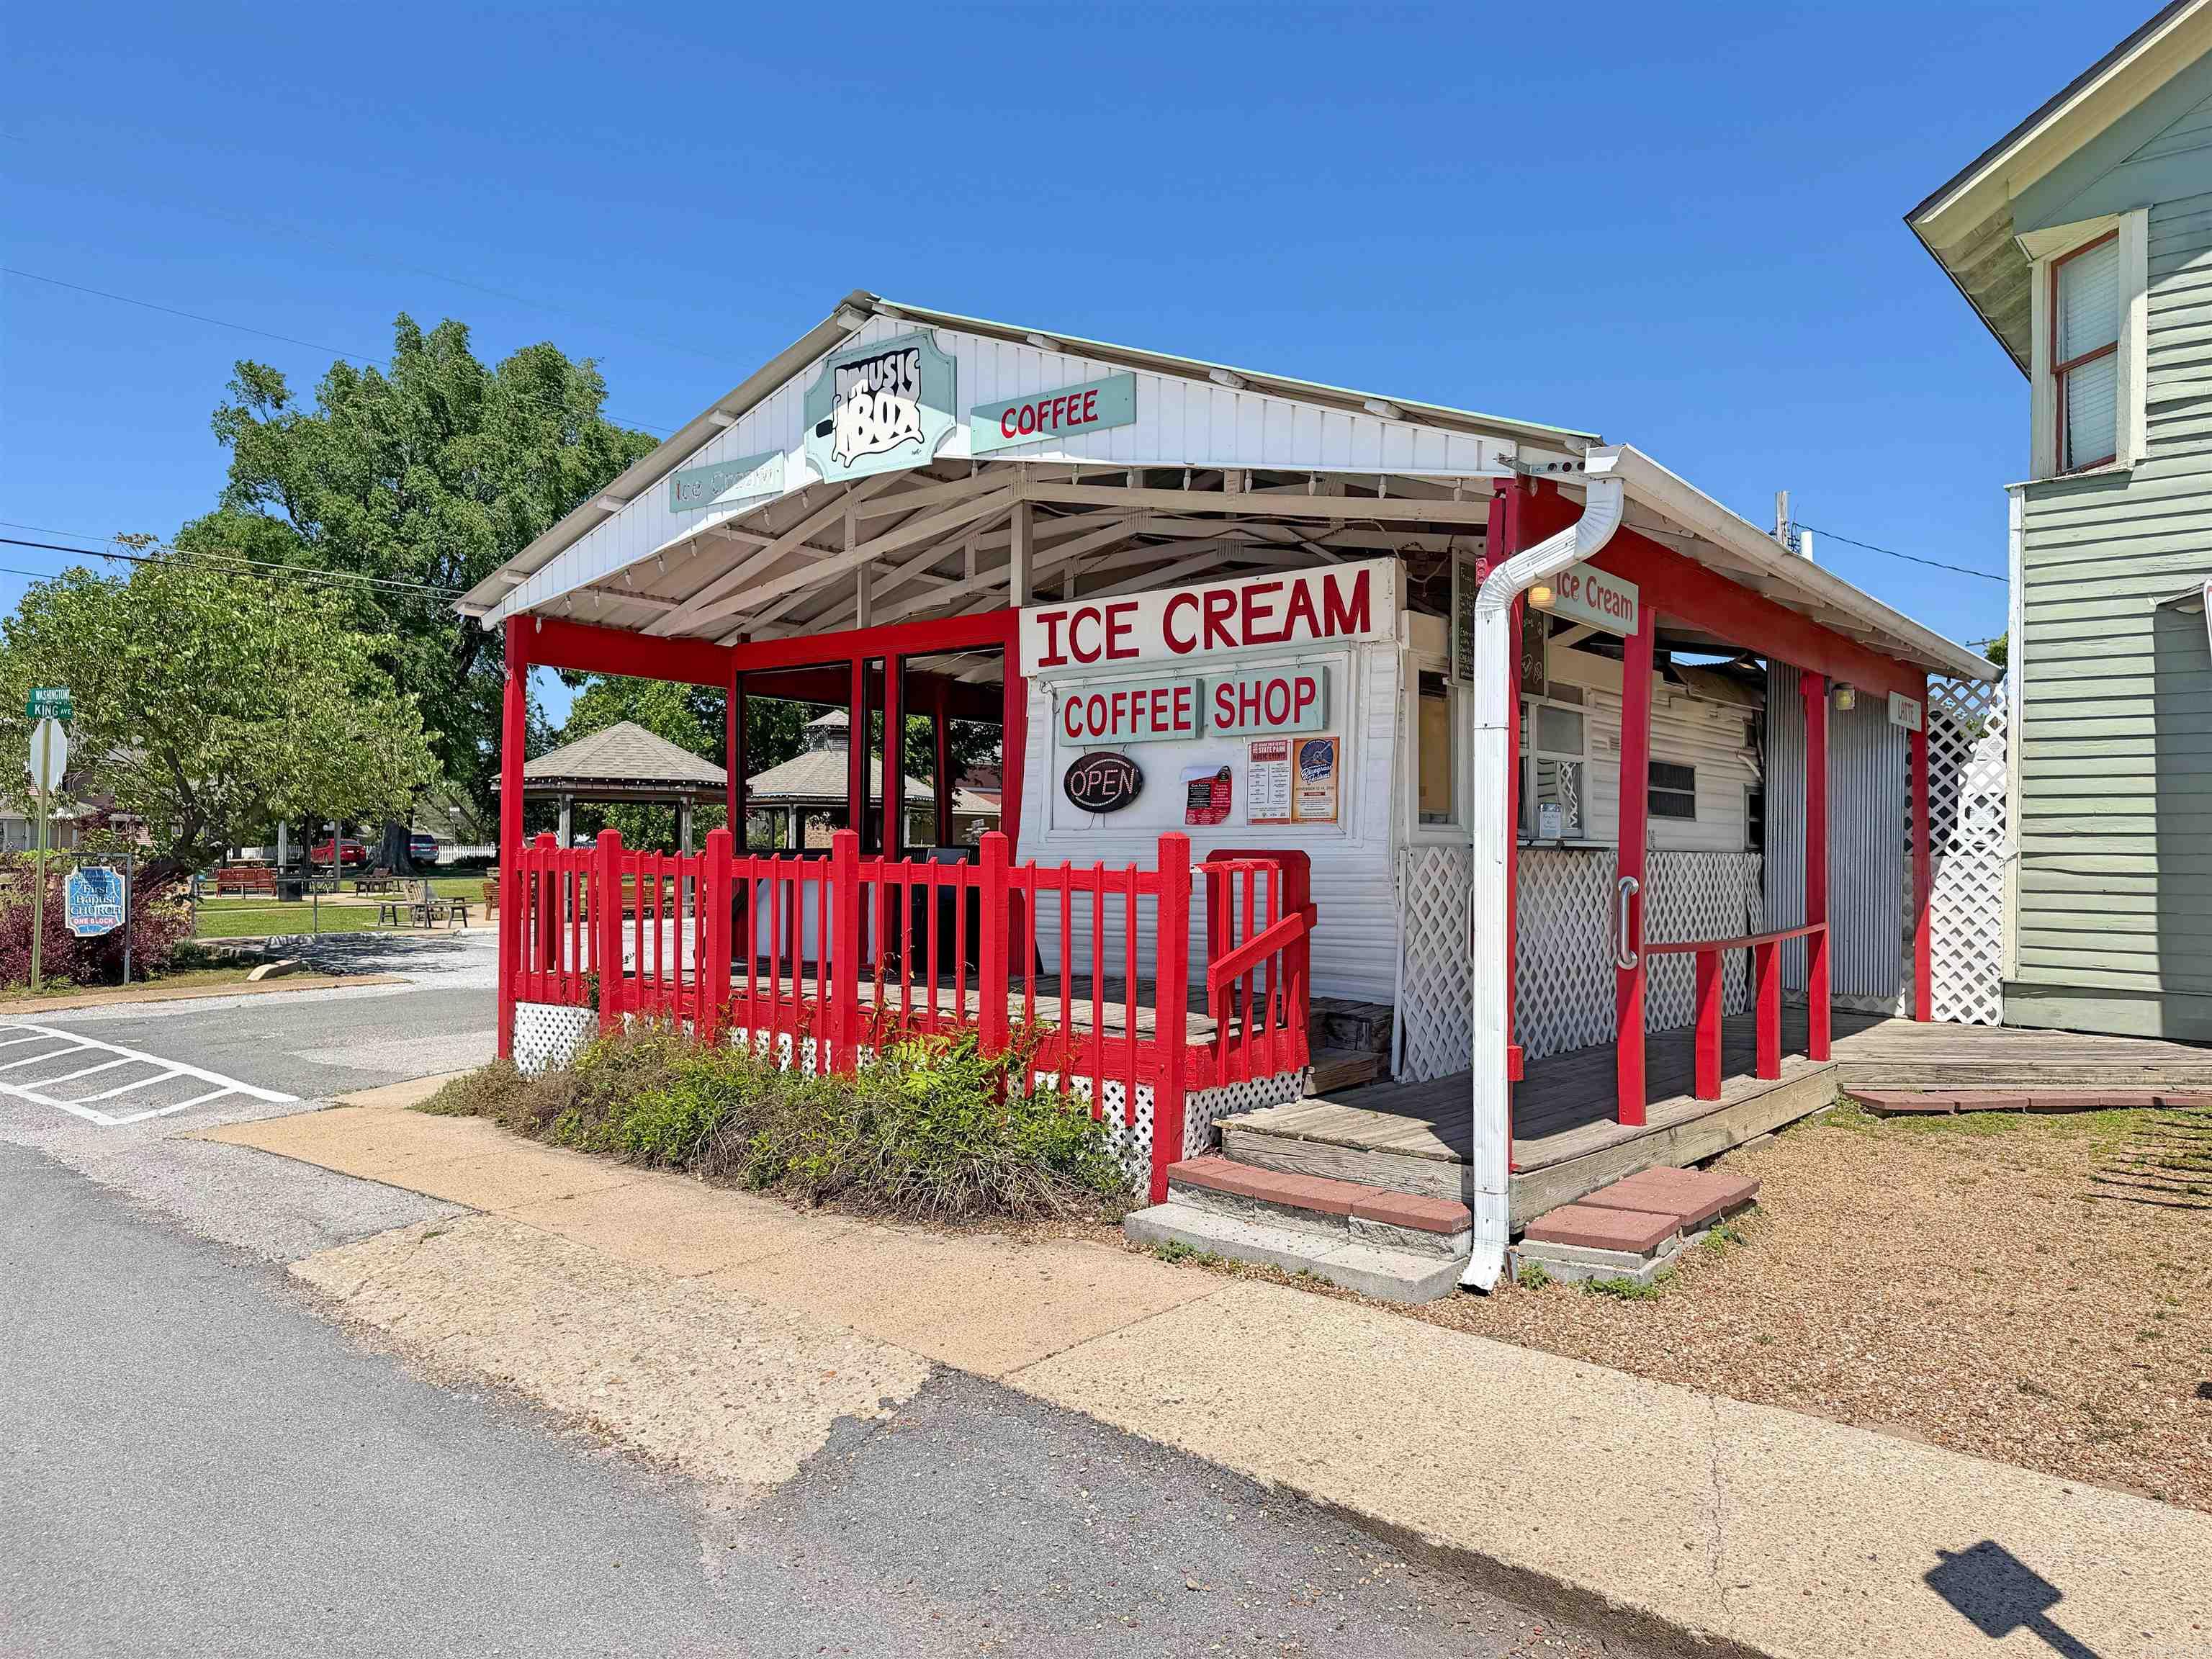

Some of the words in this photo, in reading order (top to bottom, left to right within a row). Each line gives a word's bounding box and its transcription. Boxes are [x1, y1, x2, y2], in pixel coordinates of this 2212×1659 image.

[835, 349, 920, 399] MUSIC
[836, 387, 925, 461] BOX
[1001, 390, 1098, 439] COFFEE
[676, 480, 703, 502] Ice
[1556, 571, 1580, 601] Ice
[1586, 576, 1633, 622] Cream
[1037, 601, 1140, 668] ICE
[1162, 569, 1371, 655] CREAM
[35, 688, 70, 701] WASHINGTON
[1064, 686, 1192, 738] COFFEE
[1214, 676, 1317, 729] SHOP
[35, 704, 58, 716] KING
[1898, 699, 1914, 724] LATTE
[1070, 768, 1135, 796] OPEN
[76, 894, 116, 905] Baptist
[83, 884, 108, 894] First
[70, 904, 122, 915] CHURCH
